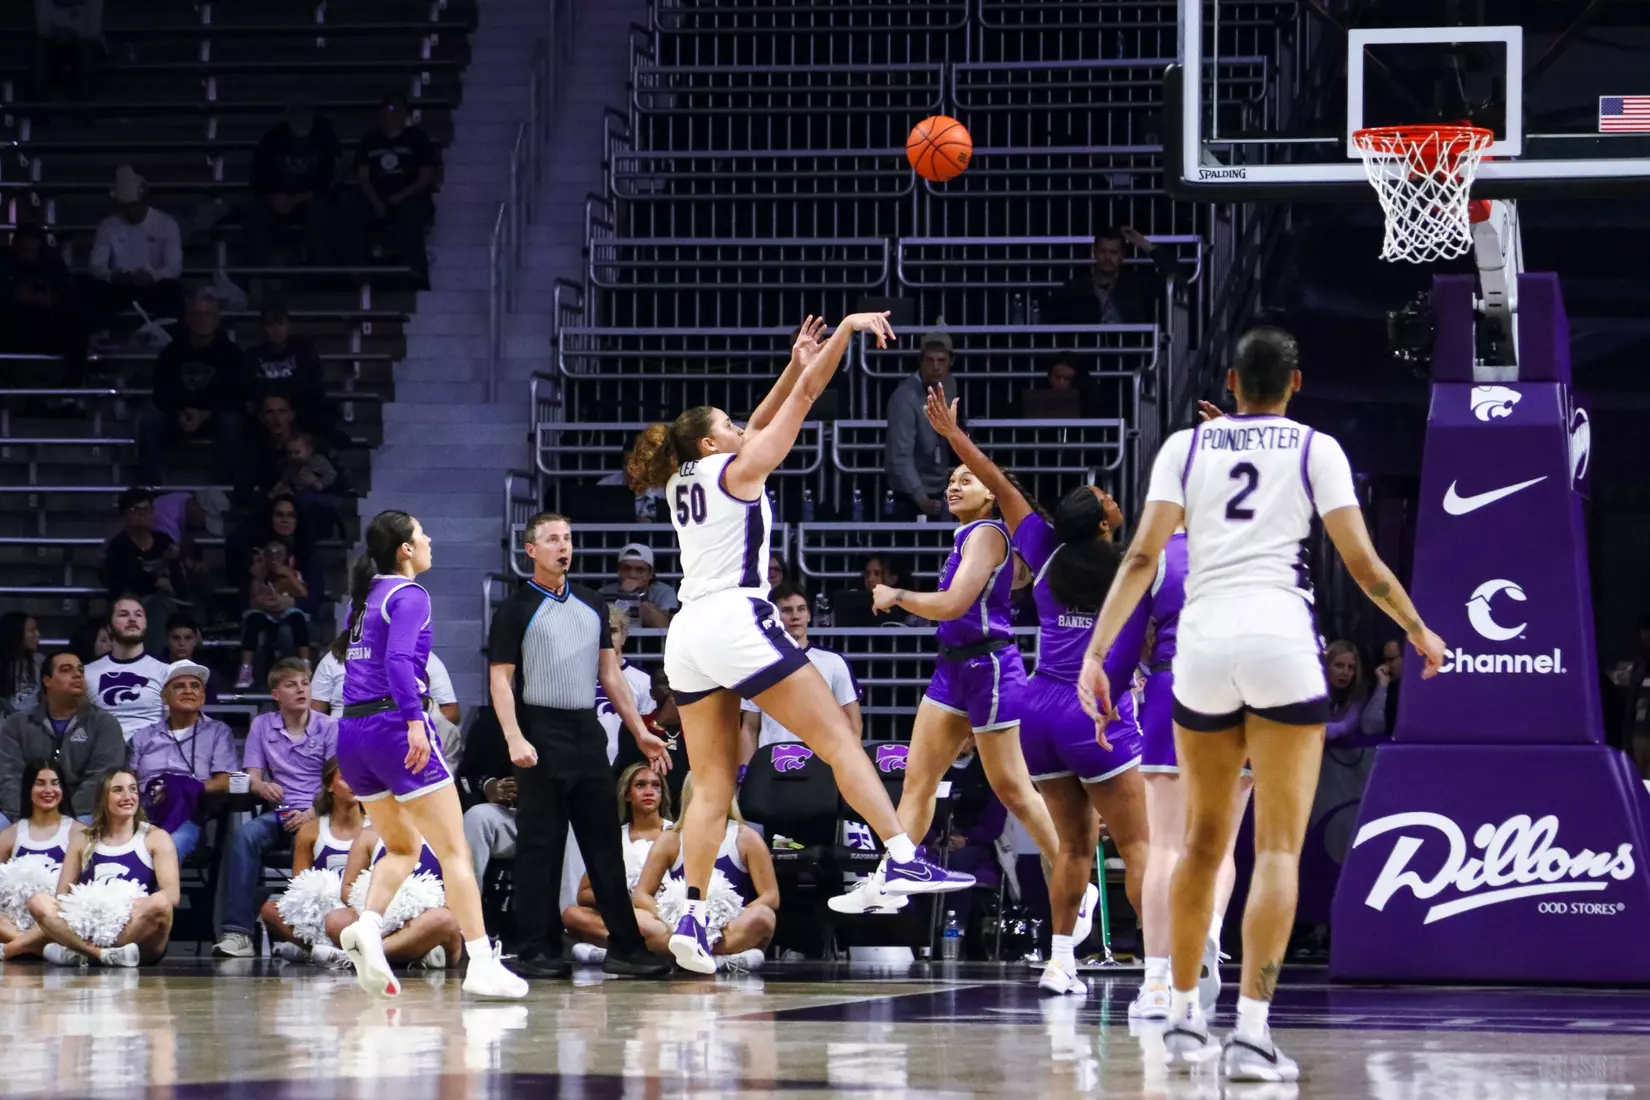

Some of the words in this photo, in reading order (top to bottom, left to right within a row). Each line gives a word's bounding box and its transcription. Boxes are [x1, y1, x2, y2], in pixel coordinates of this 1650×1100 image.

[1198, 168, 1246, 180] SPALDING
[1200, 426, 1300, 451] POINDEXTER
[679, 460, 700, 477] LEE
[1225, 461, 1259, 520] 2
[675, 482, 708, 527] 50
[1058, 614, 1093, 629] BANKS
[1352, 811, 1635, 912] Dillons
